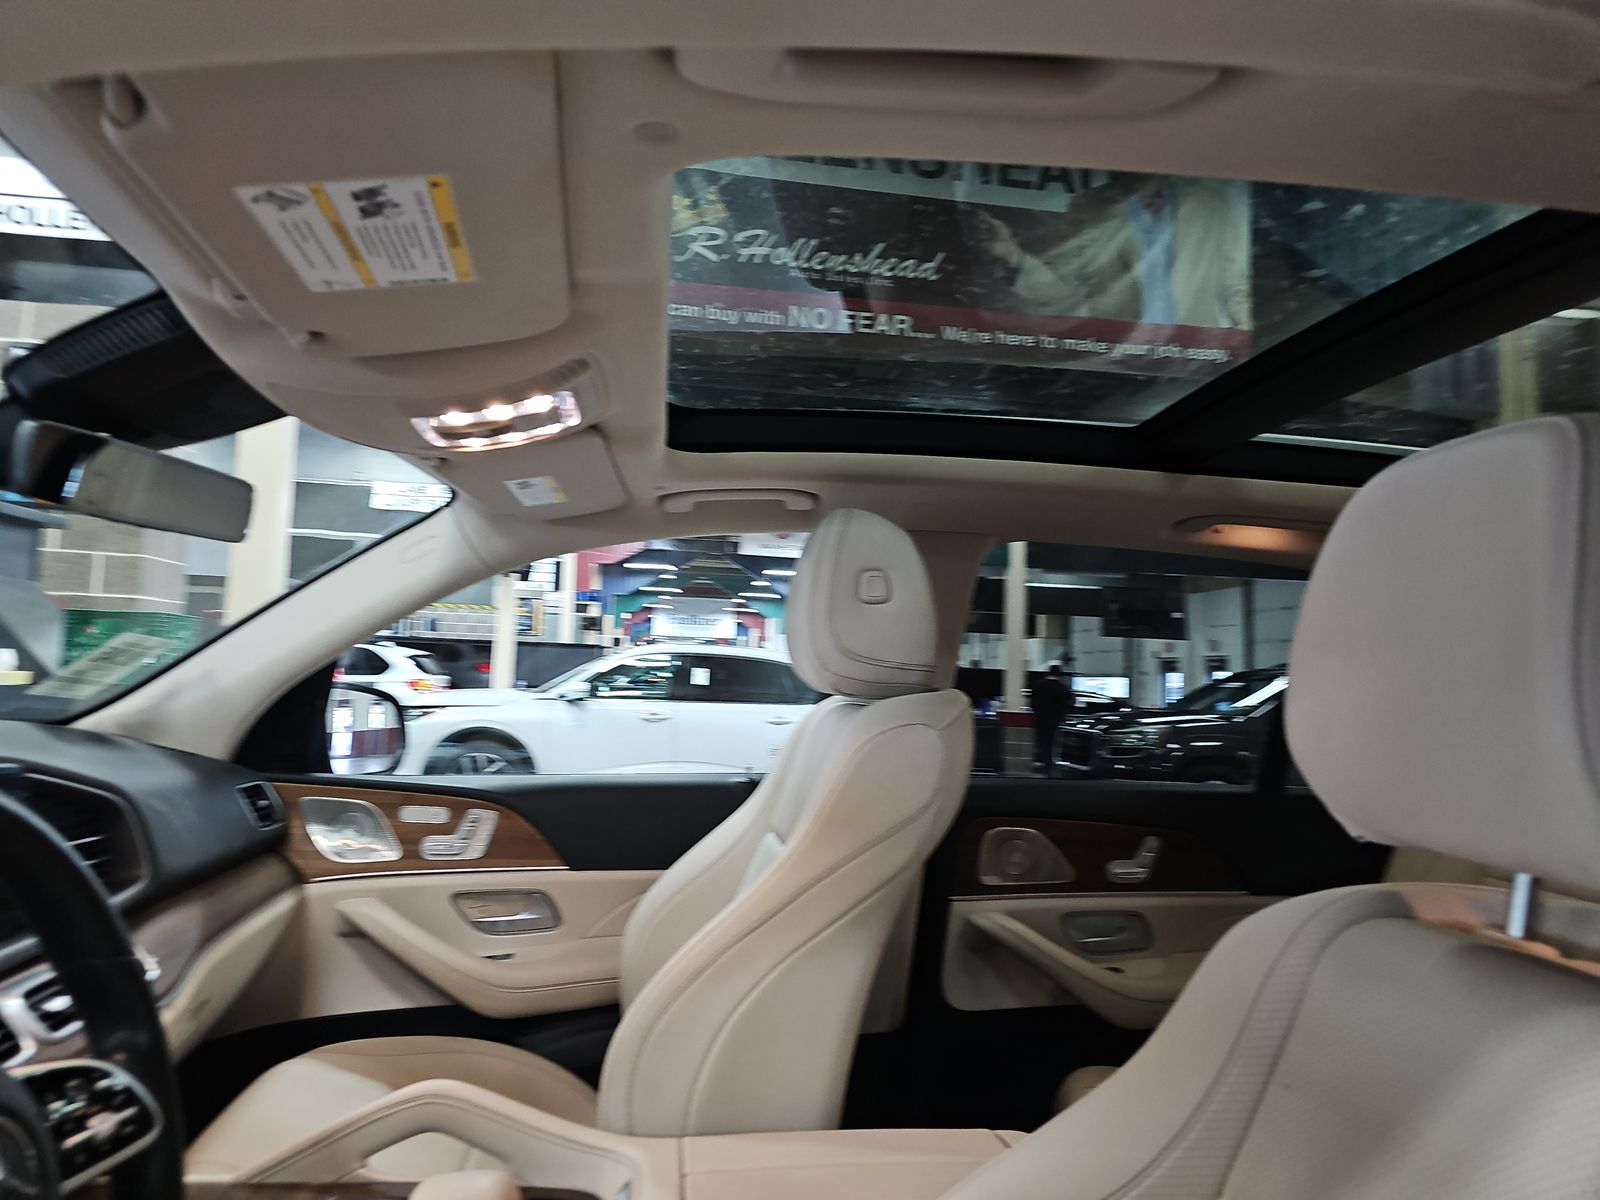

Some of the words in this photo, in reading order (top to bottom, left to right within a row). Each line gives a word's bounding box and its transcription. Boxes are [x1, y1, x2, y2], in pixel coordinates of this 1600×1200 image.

[0, 204, 90, 230] OLLE
[732, 228, 946, 281] Hollenshead
[743, 308, 786, 326] with
[787, 305, 834, 330] NO
[994, 329, 1038, 347] here
[1039, 334, 1060, 349] to
[1061, 337, 1110, 354] make
